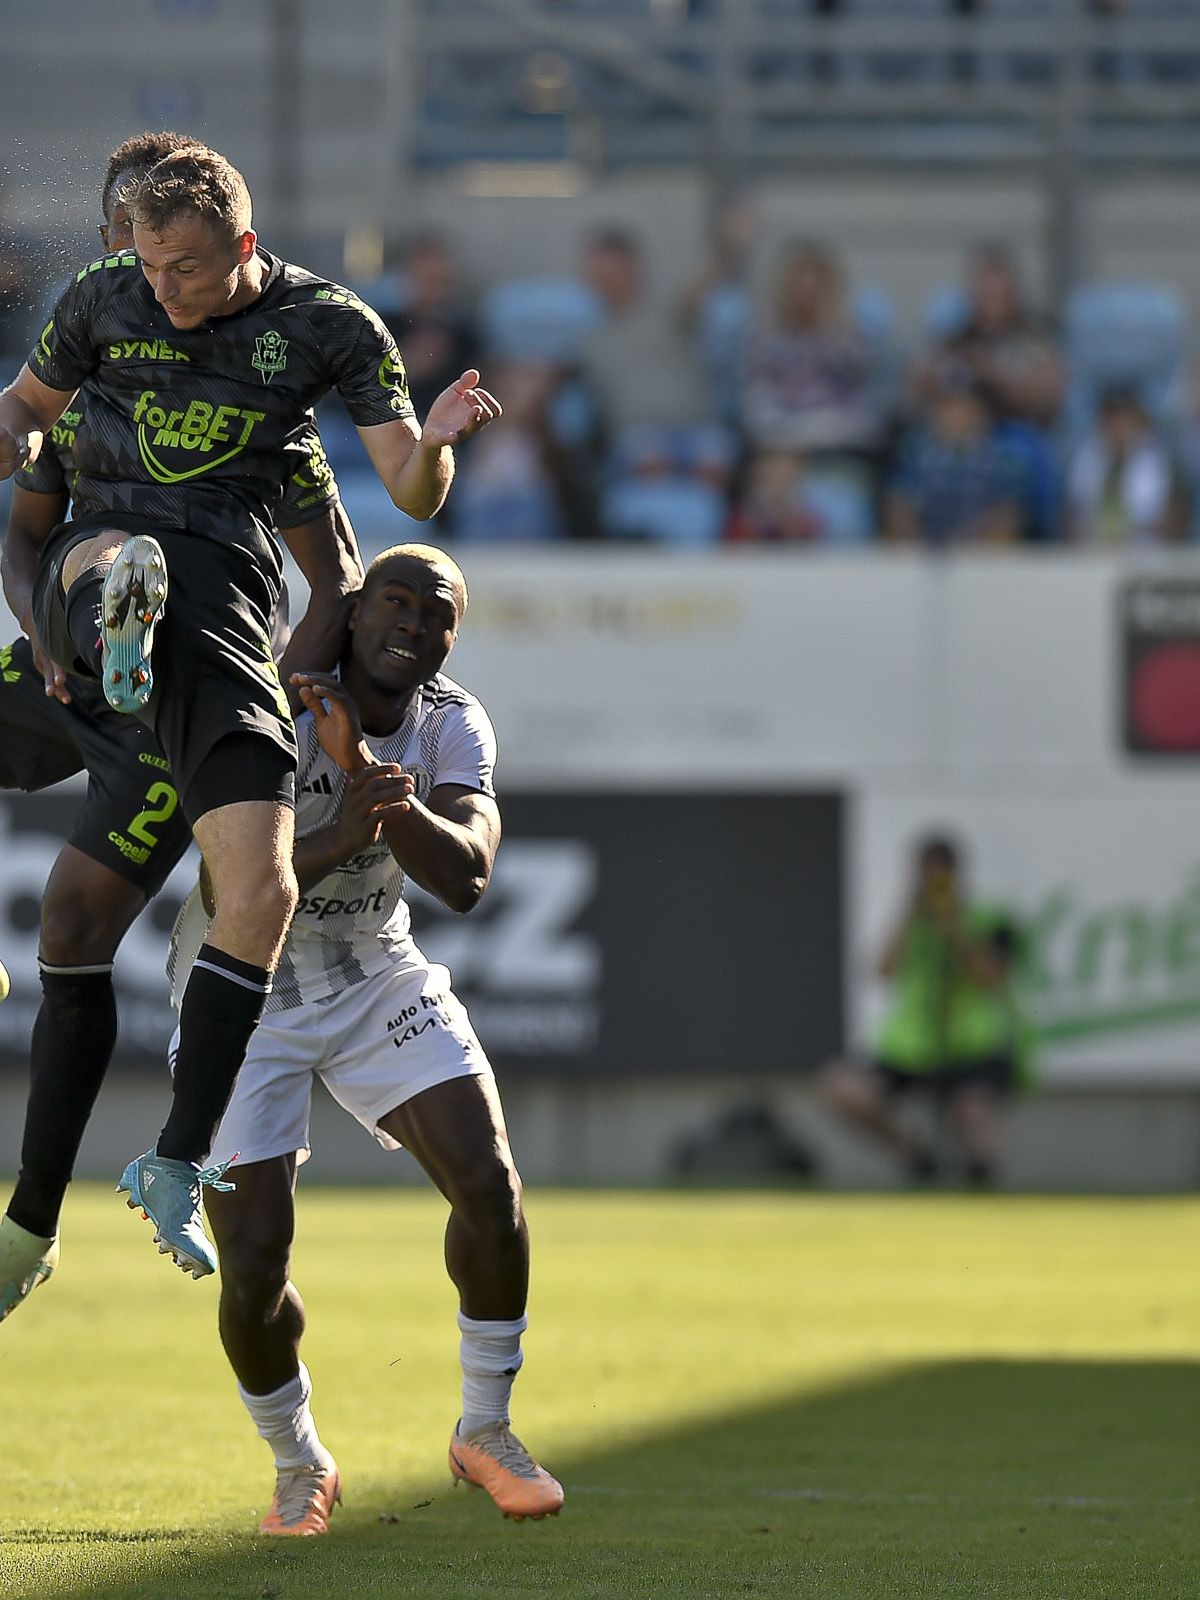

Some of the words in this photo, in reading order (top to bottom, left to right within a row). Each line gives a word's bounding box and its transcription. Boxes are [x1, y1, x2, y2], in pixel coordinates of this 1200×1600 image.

[132, 390, 266, 446] forBET
[127, 781, 178, 848] 2
[108, 831, 151, 863] capelli
[386, 1005, 418, 1032] Auto
